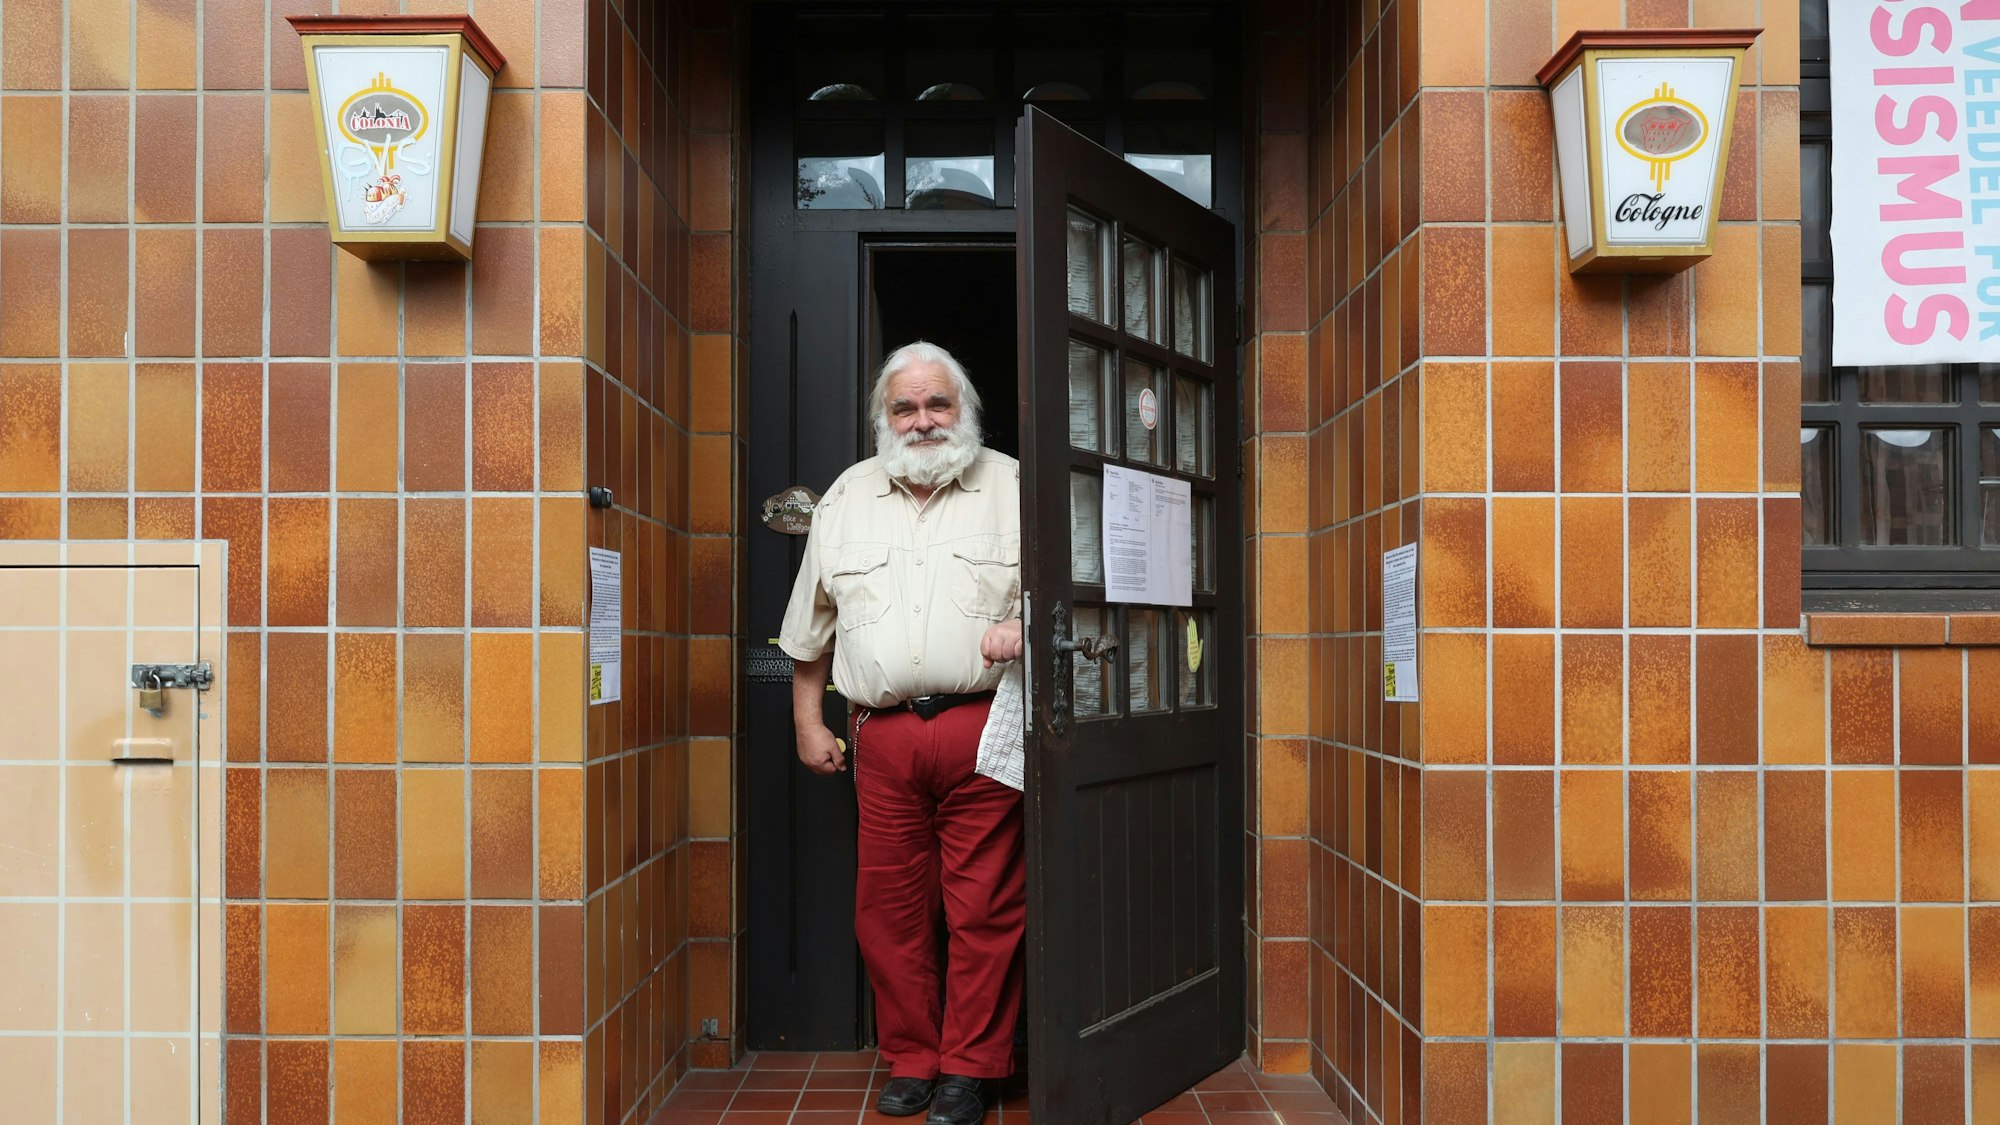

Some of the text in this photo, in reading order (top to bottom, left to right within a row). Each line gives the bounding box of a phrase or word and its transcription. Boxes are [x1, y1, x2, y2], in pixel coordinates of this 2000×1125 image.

[351, 115, 411, 131] COLONIA
[1869, 0, 1970, 345] SISMUS
[1962, 36, 2000, 225] VEEDEL
[1615, 192, 1703, 230] Cologne
